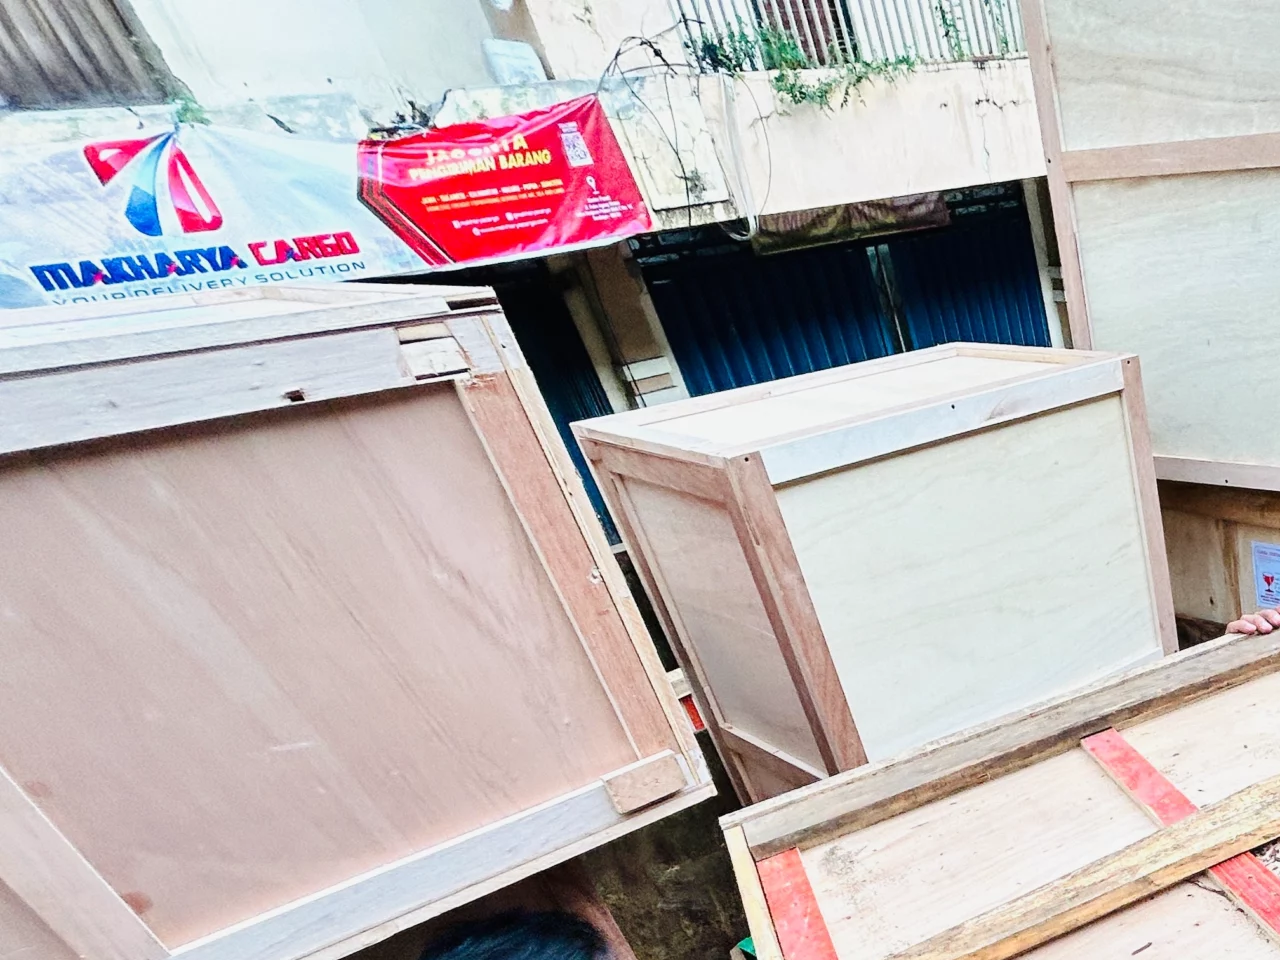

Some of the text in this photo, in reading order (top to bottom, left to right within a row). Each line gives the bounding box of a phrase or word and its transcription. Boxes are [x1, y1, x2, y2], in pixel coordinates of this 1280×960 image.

[498, 148, 552, 170] BARANG
[30, 231, 361, 292] MAKHARYA CARGO
[134, 276, 247, 298] DELIVERY
[255, 261, 366, 284] SOLUTION
